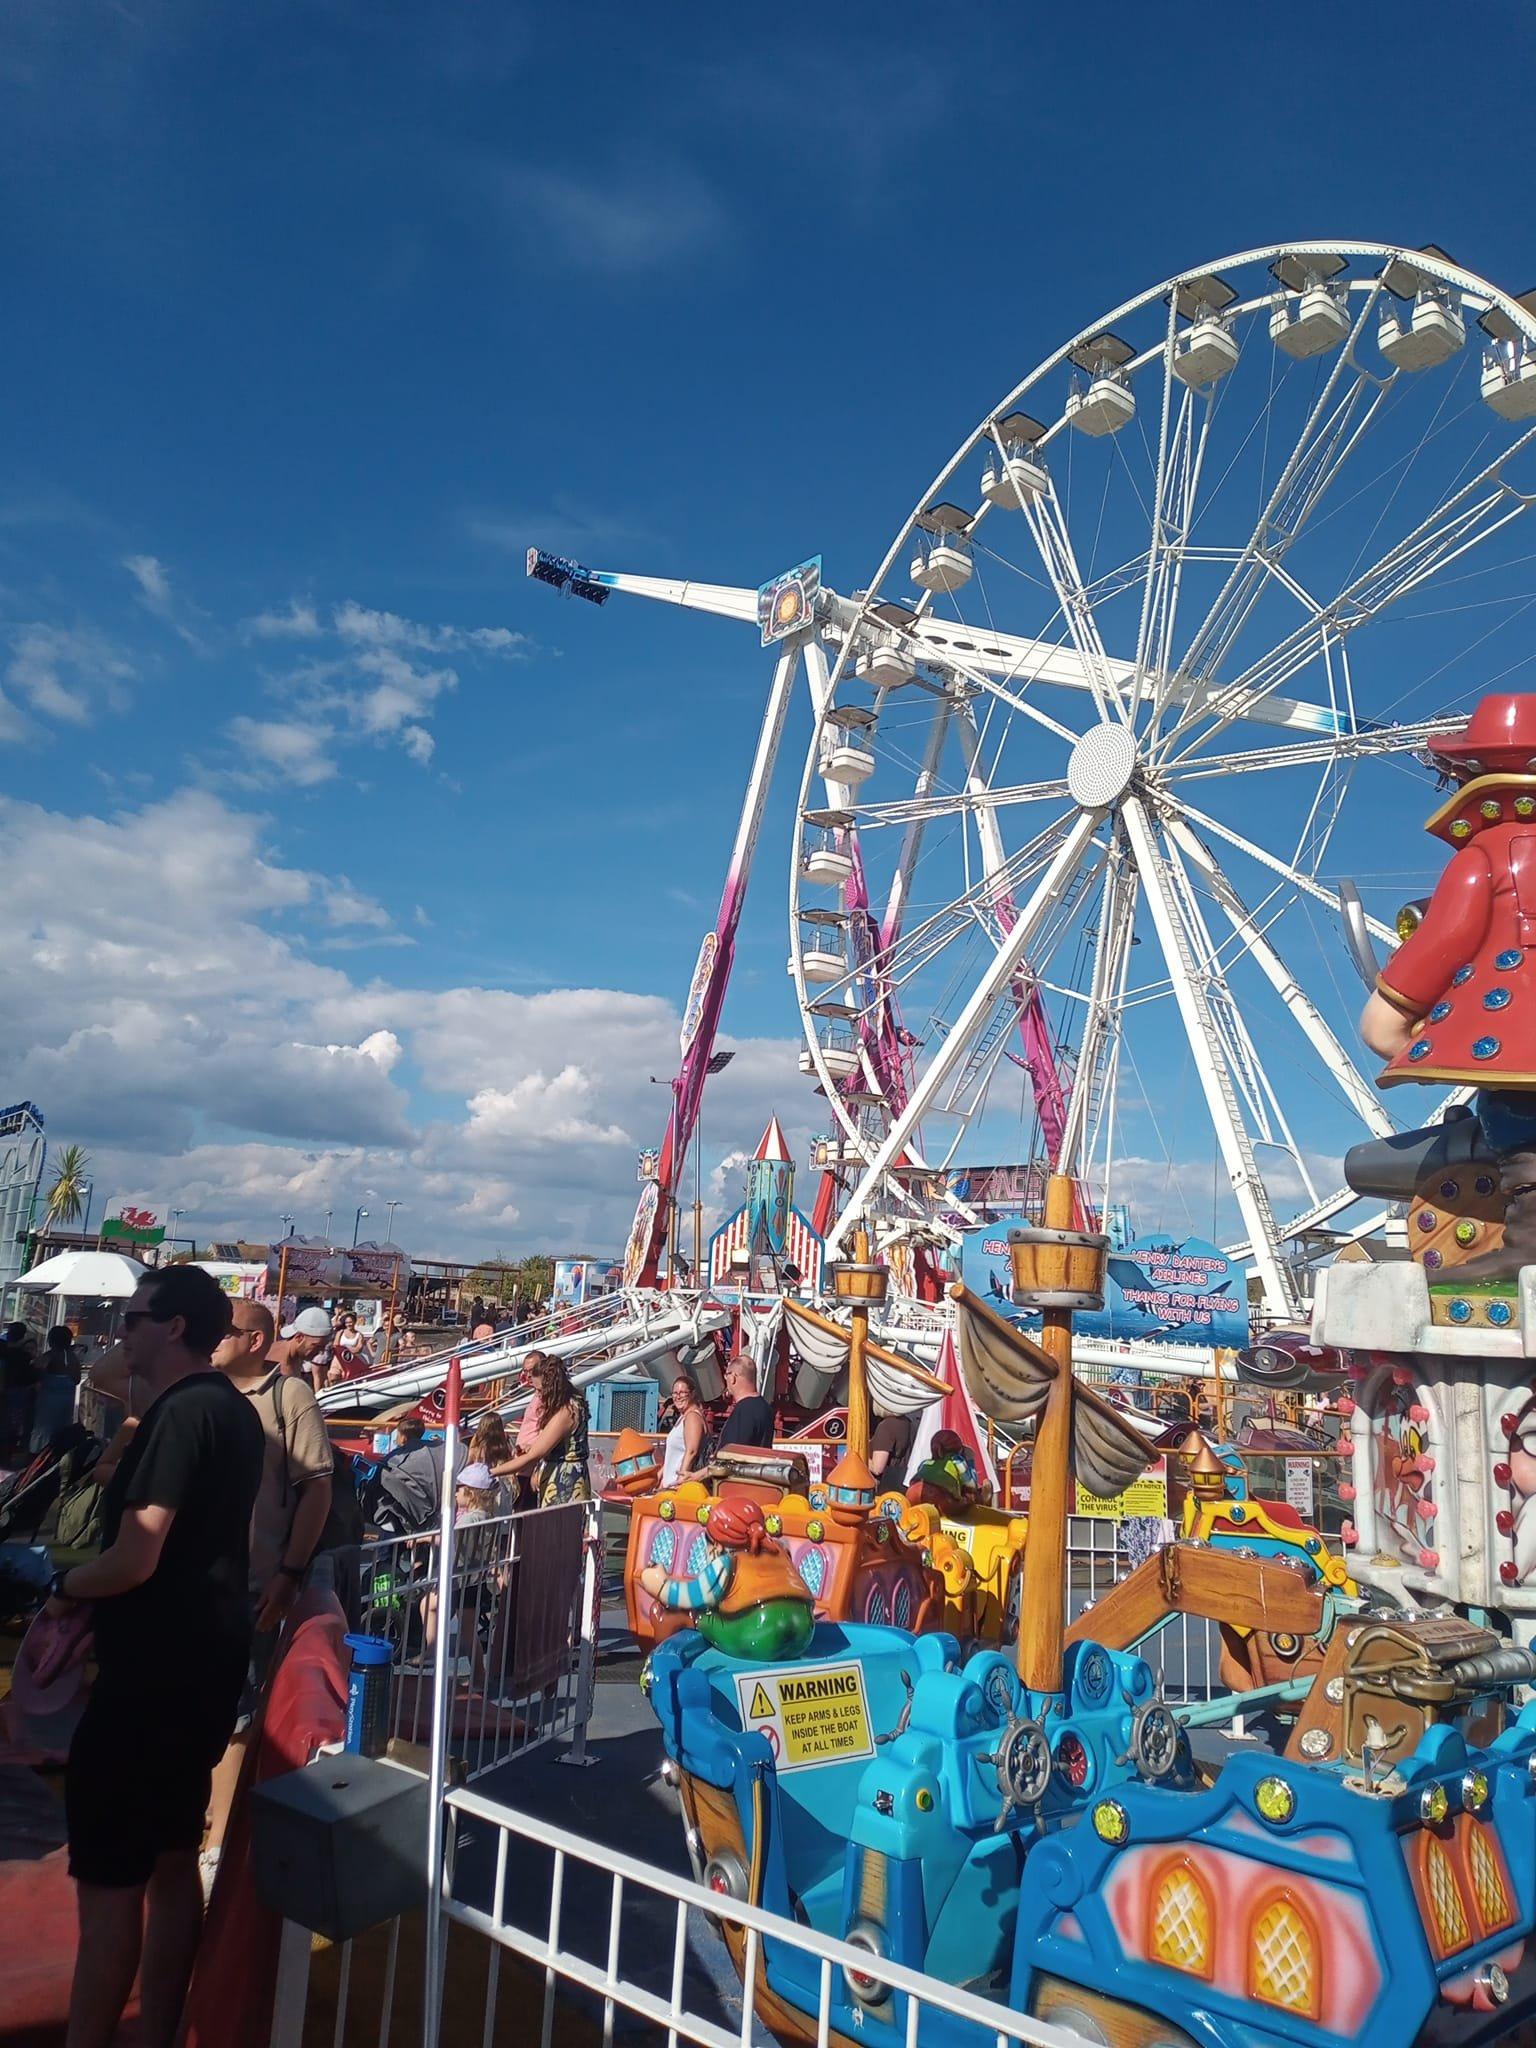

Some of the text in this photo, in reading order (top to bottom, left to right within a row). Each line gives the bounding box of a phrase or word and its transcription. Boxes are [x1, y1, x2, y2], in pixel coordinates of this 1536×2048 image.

[982, 1239, 1011, 1255] HEN
[1131, 1250, 1227, 1273] HENRY DANTER'S
[1151, 1268, 1208, 1286] AIRLINES
[1122, 1288, 1240, 1313] THANKS FOR FLYING
[1157, 1307, 1211, 1325] WITH US
[1287, 1461, 1310, 1469] WARNING
[1081, 1503, 1118, 1512] THE VIRUS
[779, 1675, 857, 1701] WARNING
[784, 1705, 861, 1725] KEEP ARMS & LEGS
[791, 1720, 859, 1740] INSIDE THE BOAT
[802, 1736, 854, 1754] AT ALL TIMES
